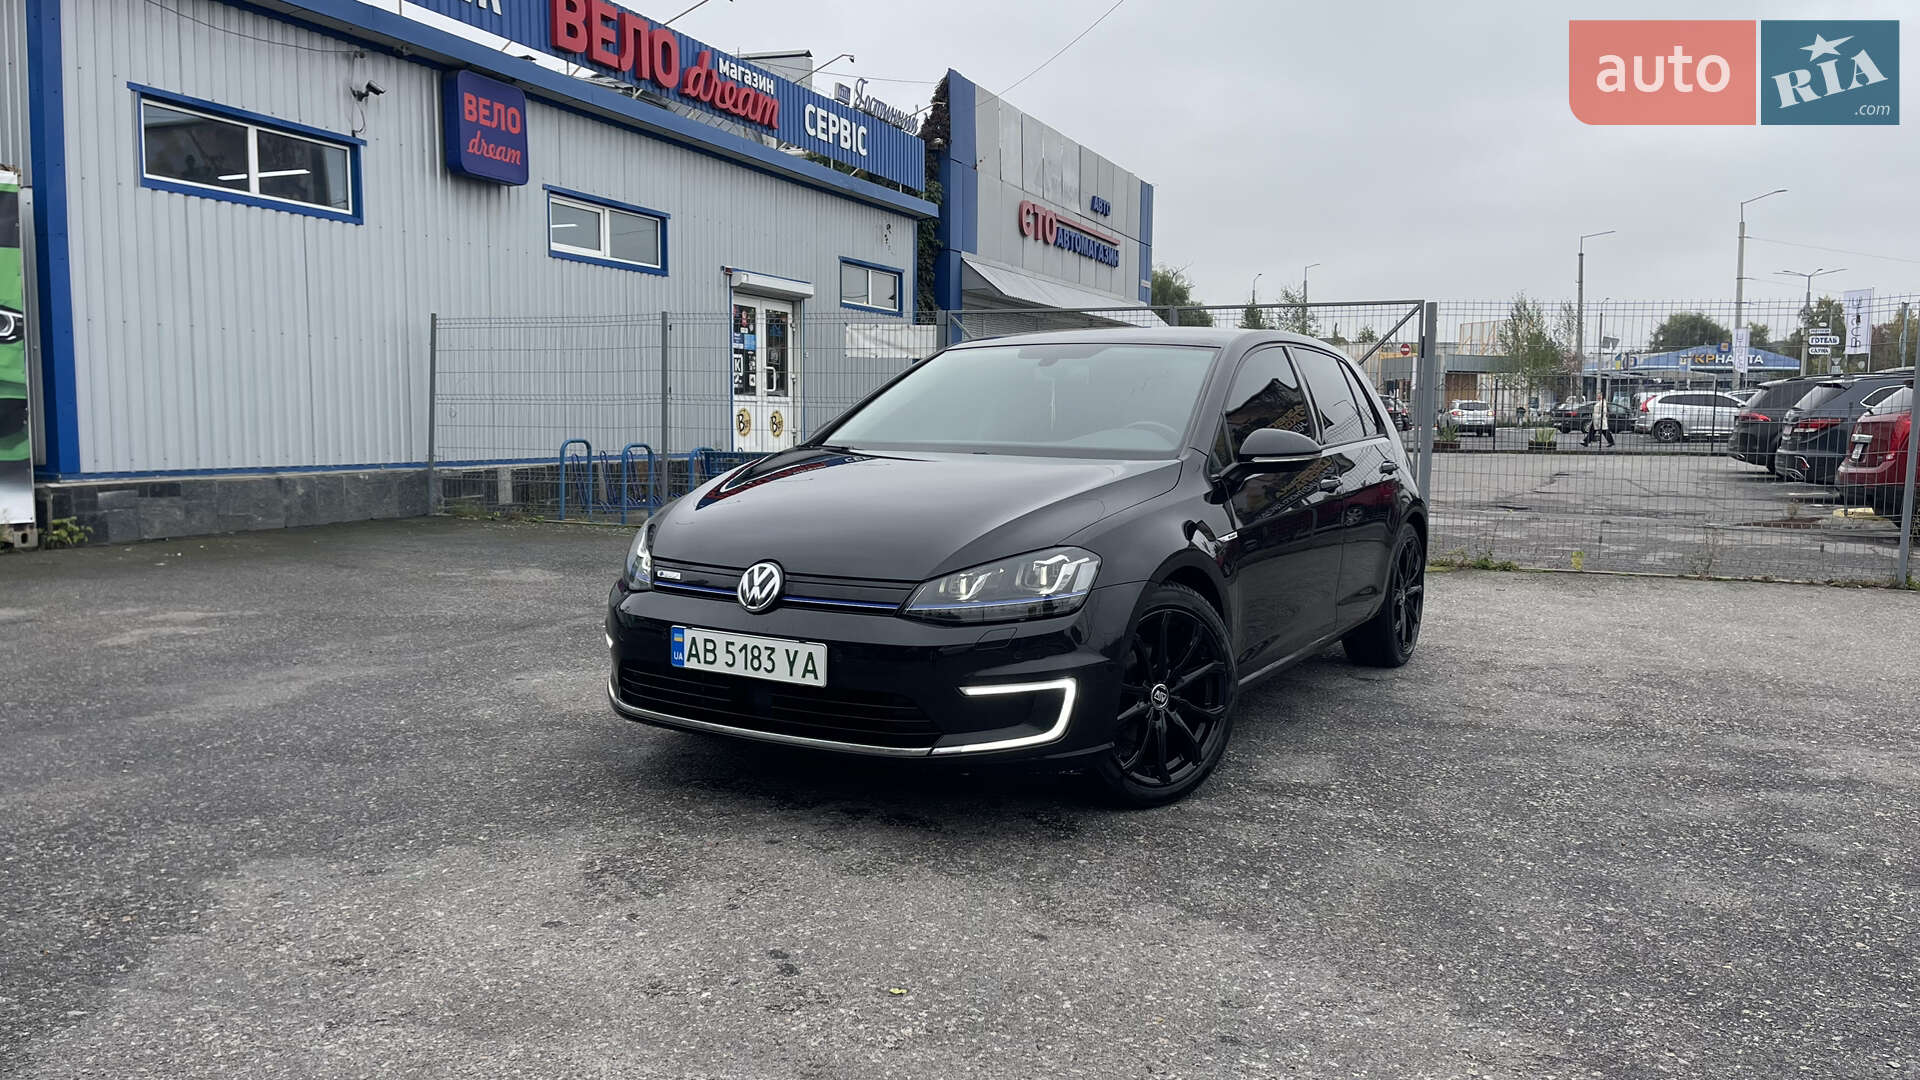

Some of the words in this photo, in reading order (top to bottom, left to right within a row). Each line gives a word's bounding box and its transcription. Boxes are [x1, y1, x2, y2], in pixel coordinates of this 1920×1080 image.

[551, 0, 680, 88] ВЕЛО
[680, 50, 779, 129] dream
[718, 57, 774, 95] магазин
[463, 92, 521, 135] ВЕЛО
[804, 103, 867, 156] СЕРВІС
[466, 130, 521, 166] dream
[1091, 195, 1111, 217] АВТО
[1054, 226, 1119, 268] АВТОМАГАЗИН
[1691, 353, 1764, 365] КРНАТА
[1810, 336, 1838, 345] ГОТЕЛЬ
[673, 650, 684, 661] UA
[686, 636, 717, 666] AB
[725, 640, 776, 674] 5183
[785, 649, 819, 681] YA
